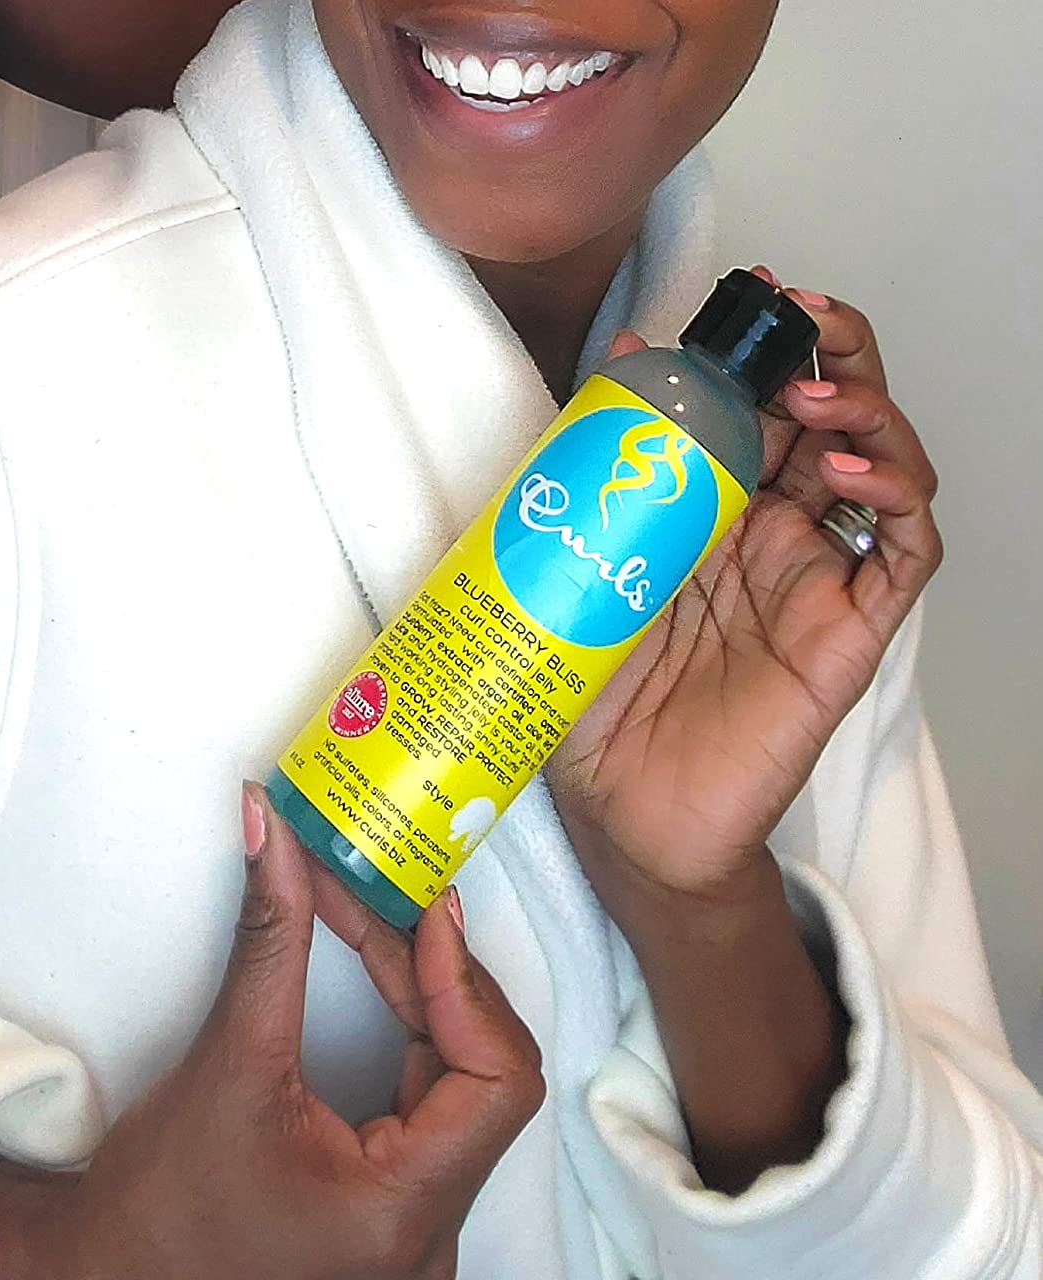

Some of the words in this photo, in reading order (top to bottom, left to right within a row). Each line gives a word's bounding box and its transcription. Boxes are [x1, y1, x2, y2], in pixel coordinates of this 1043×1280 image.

[519, 473, 650, 612] Curls
[408, 633, 427, 651] and
[425, 647, 498, 716] hydrogenated
[448, 615, 477, 643] Need
[475, 640, 497, 661] curl
[495, 659, 541, 703] definition
[453, 572, 549, 655] BLUEBERRY
[546, 653, 586, 695] BLISS
[460, 604, 487, 629] curl
[485, 626, 535, 672] control
[529, 667, 558, 695] jelly
[389, 671, 401, 684] to
[399, 642, 434, 677] working
[433, 674, 469, 710] styling
[466, 705, 492, 728] jelly
[499, 735, 521, 756] your
[401, 662, 416, 676] for
[414, 673, 438, 699] long
[474, 730, 502, 757] shiny
[462, 644, 485, 669] with
[495, 676, 536, 716] certified
[477, 678, 509, 710] argan
[322, 737, 337, 753] NO
[384, 720, 422, 761] tresses.
[388, 709, 442, 759] damaged
[396, 697, 419, 718] and
[416, 714, 472, 765] RESTORE
[313, 750, 346, 783] artificial
[393, 829, 405, 841] or
[327, 786, 407, 868] www.curls.biz
[422, 780, 454, 811] style
